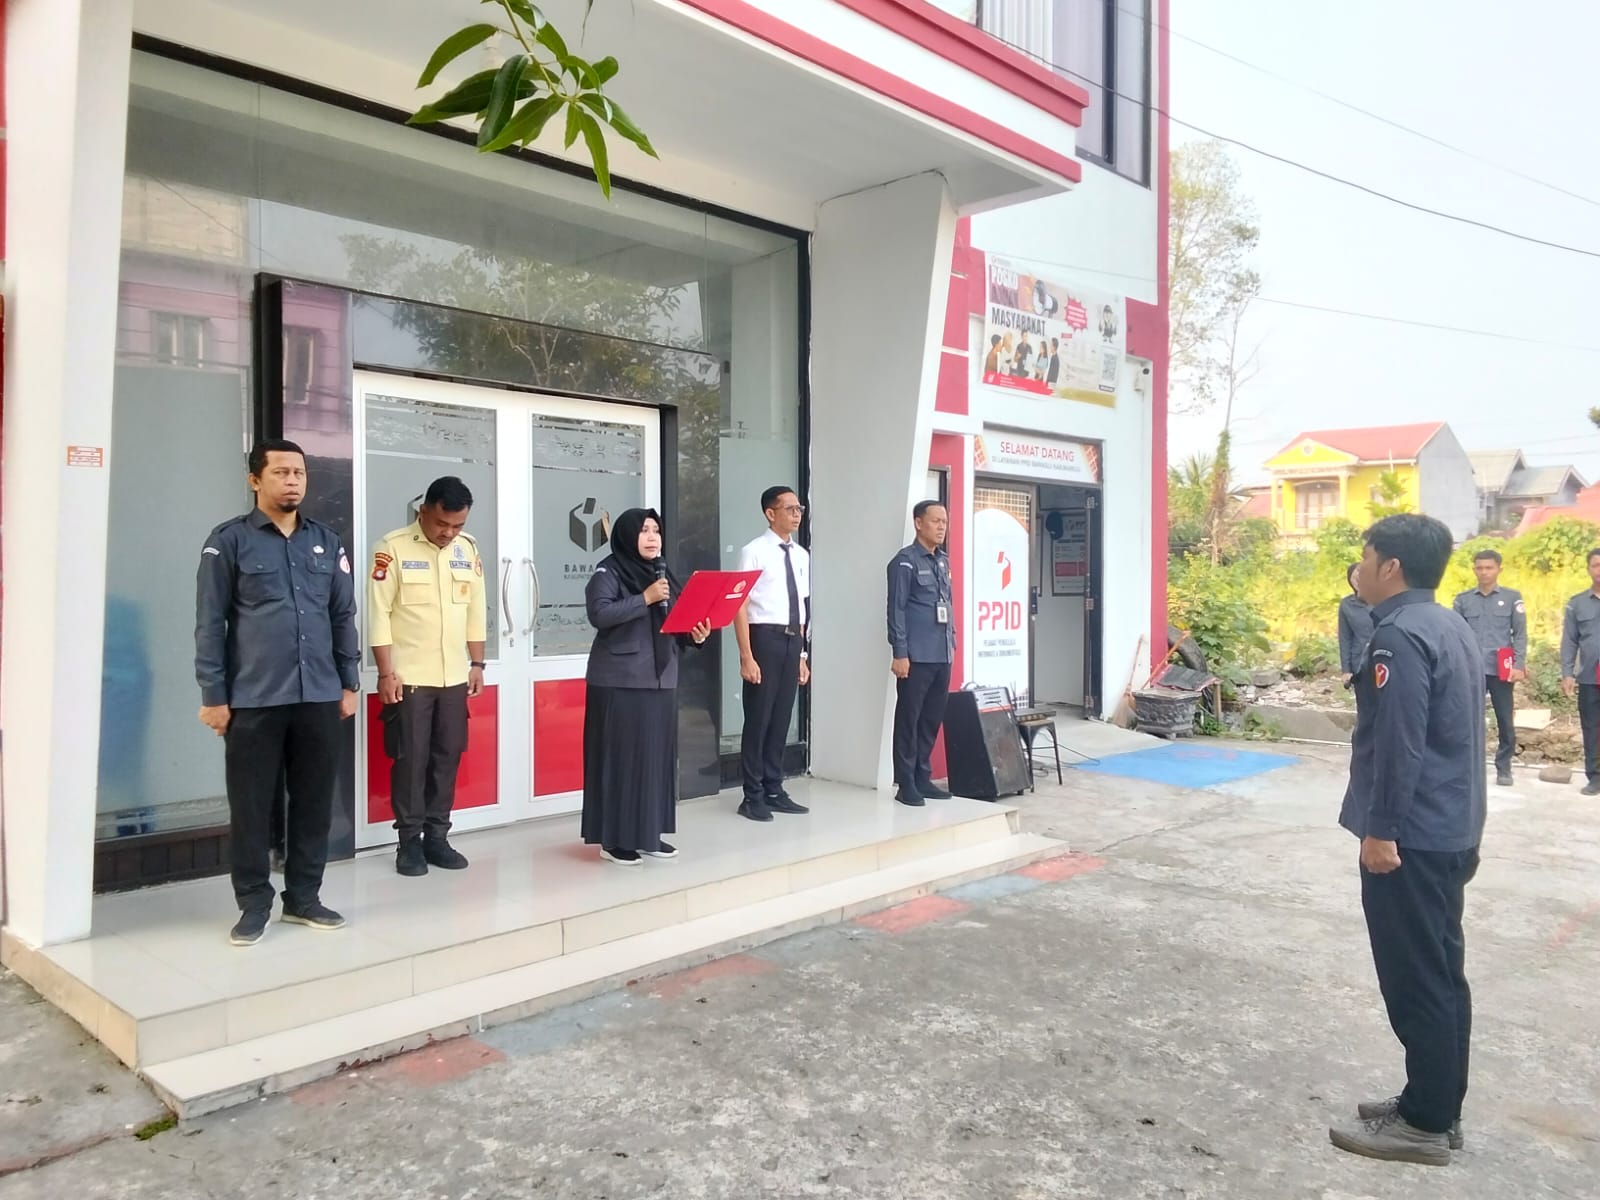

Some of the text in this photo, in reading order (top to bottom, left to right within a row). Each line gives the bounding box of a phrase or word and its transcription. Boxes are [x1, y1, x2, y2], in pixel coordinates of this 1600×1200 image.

[991, 307, 1046, 337] MASYARAKAT
[1000, 441, 1075, 462] SELAMAT DATANG
[564, 564, 594, 573] BAWA
[978, 601, 1021, 631] PPID
